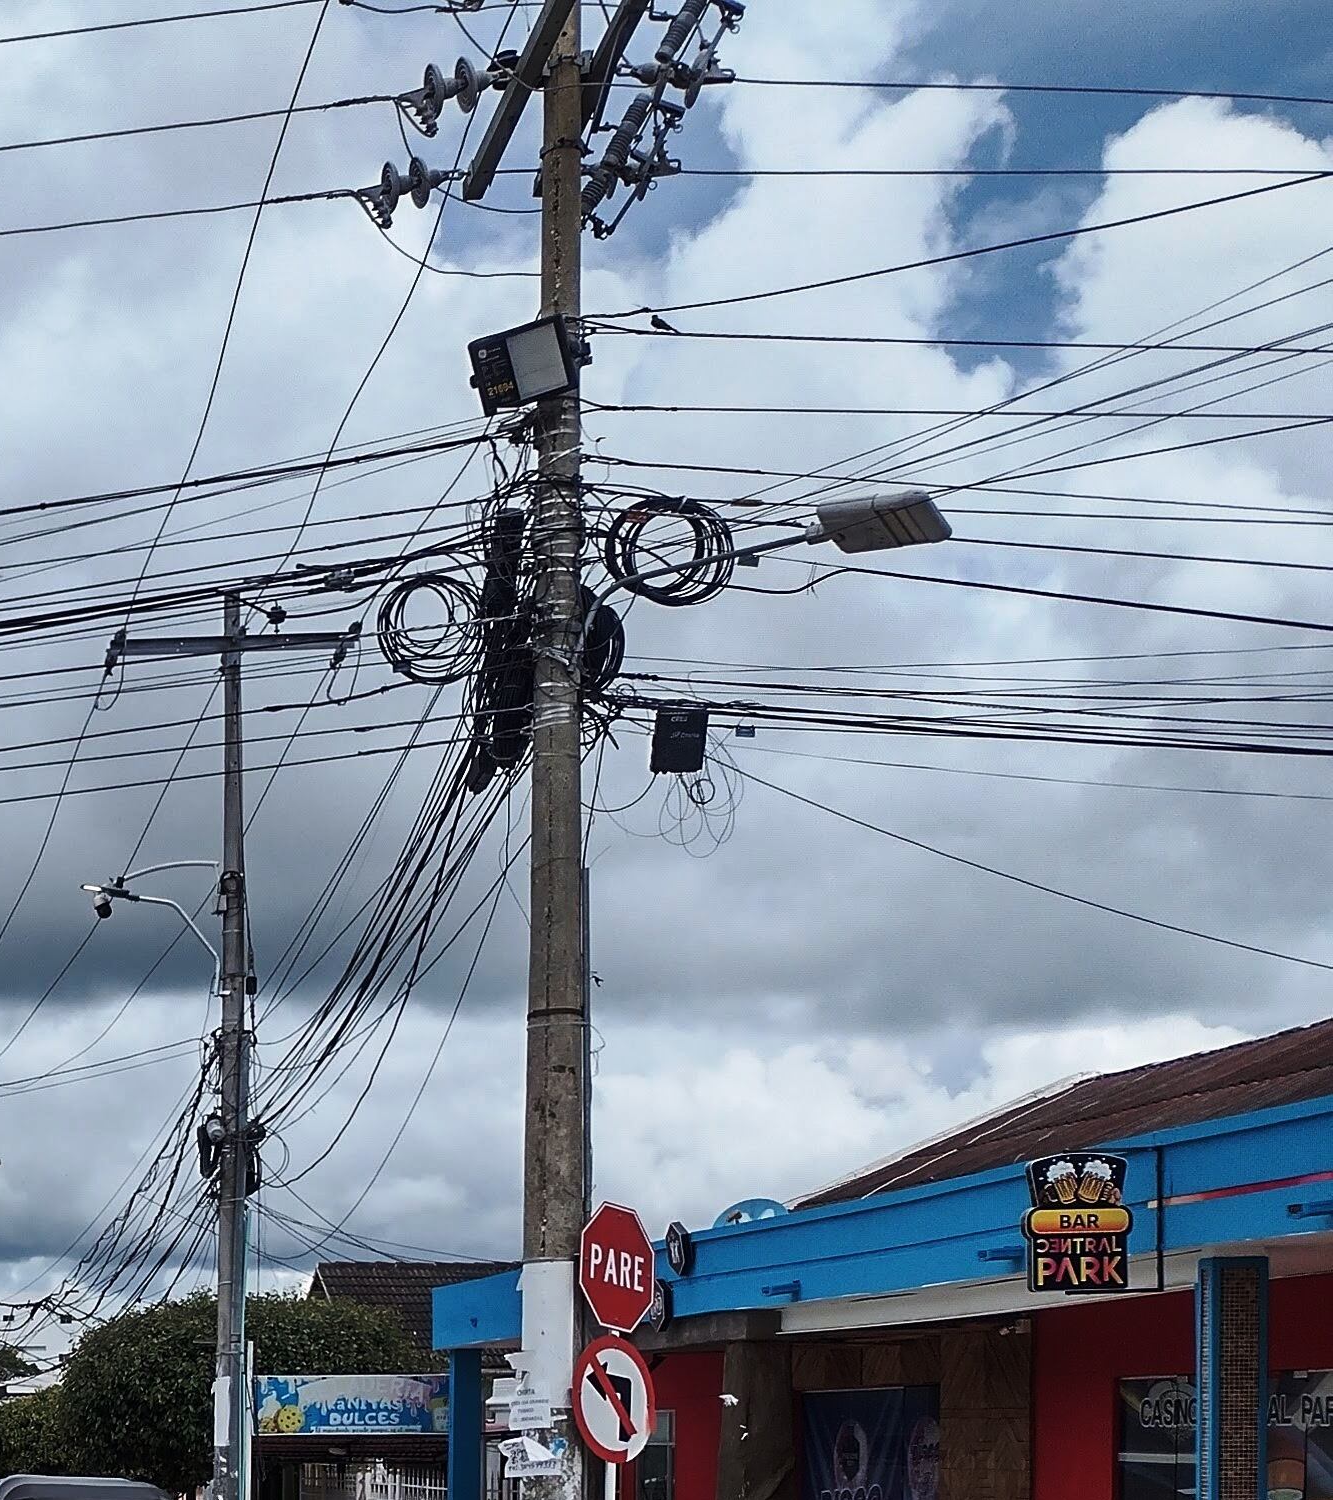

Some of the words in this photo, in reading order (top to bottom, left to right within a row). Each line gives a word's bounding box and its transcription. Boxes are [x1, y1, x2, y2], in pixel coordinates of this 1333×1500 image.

[1059, 1214, 1100, 1229] BAR
[1036, 1236, 1122, 1254] CENTRAL
[590, 1243, 644, 1292] PARE
[1036, 1256, 1124, 1285] PARK
[329, 1412, 410, 1425] DULCES
